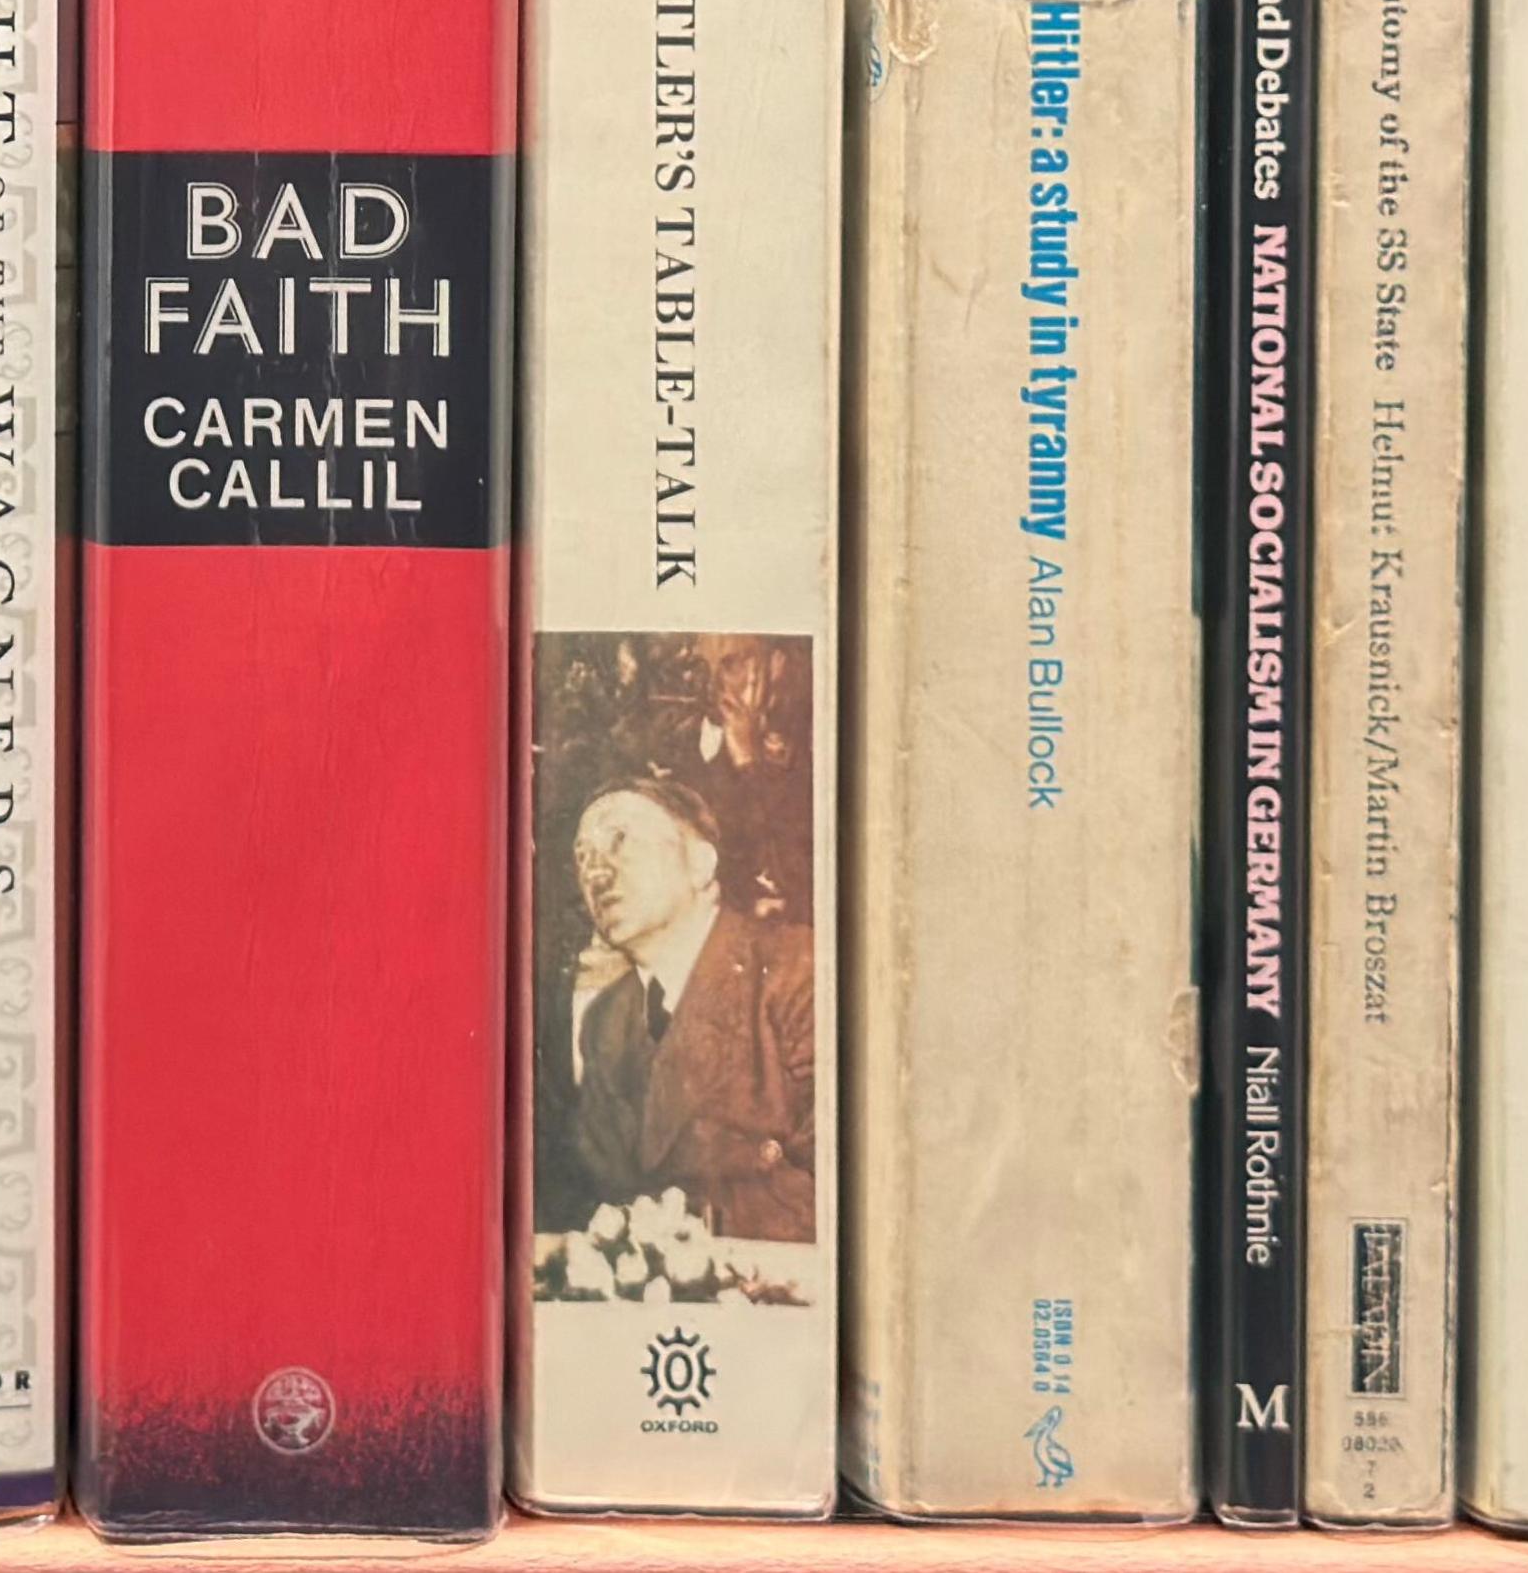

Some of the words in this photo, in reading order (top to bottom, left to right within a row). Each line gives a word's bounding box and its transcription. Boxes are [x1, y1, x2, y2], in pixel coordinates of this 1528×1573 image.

[1029, 2, 1079, 140] Hitler:
[1029, 147, 1069, 175] a
[1254, 37, 1291, 198] Debates
[1379, 112, 1412, 151] of
[186, 182, 411, 260] BAD
[1378, 158, 1410, 216] the
[1021, 180, 1079, 306] study
[1376, 230, 1407, 274] SS
[145, 277, 450, 358] FAITH
[1029, 316, 1079, 355] in
[1249, 224, 1287, 454] NATIONAL
[1375, 285, 1405, 373] State
[145, 395, 448, 449] CARMEN
[656, 208, 697, 588] TABLE-TALK
[169, 458, 422, 510] CALLIL
[1021, 364, 1079, 541] tyranny
[1372, 399, 1405, 537] Helmut
[1027, 555, 1063, 648] Alan
[1248, 461, 1284, 725] SOCIALISM
[1027, 657, 1063, 808] Bullock
[1247, 730, 1282, 780] IN
[1247, 786, 1282, 1017] GERMANY
[1364, 893, 1396, 1025] Broszat
[1248, 1046, 1279, 1122] Niall
[1248, 1131, 1279, 1266] Rothnie
[640, 1419, 718, 1434] OXFORD
[1236, 1384, 1291, 1431] M
